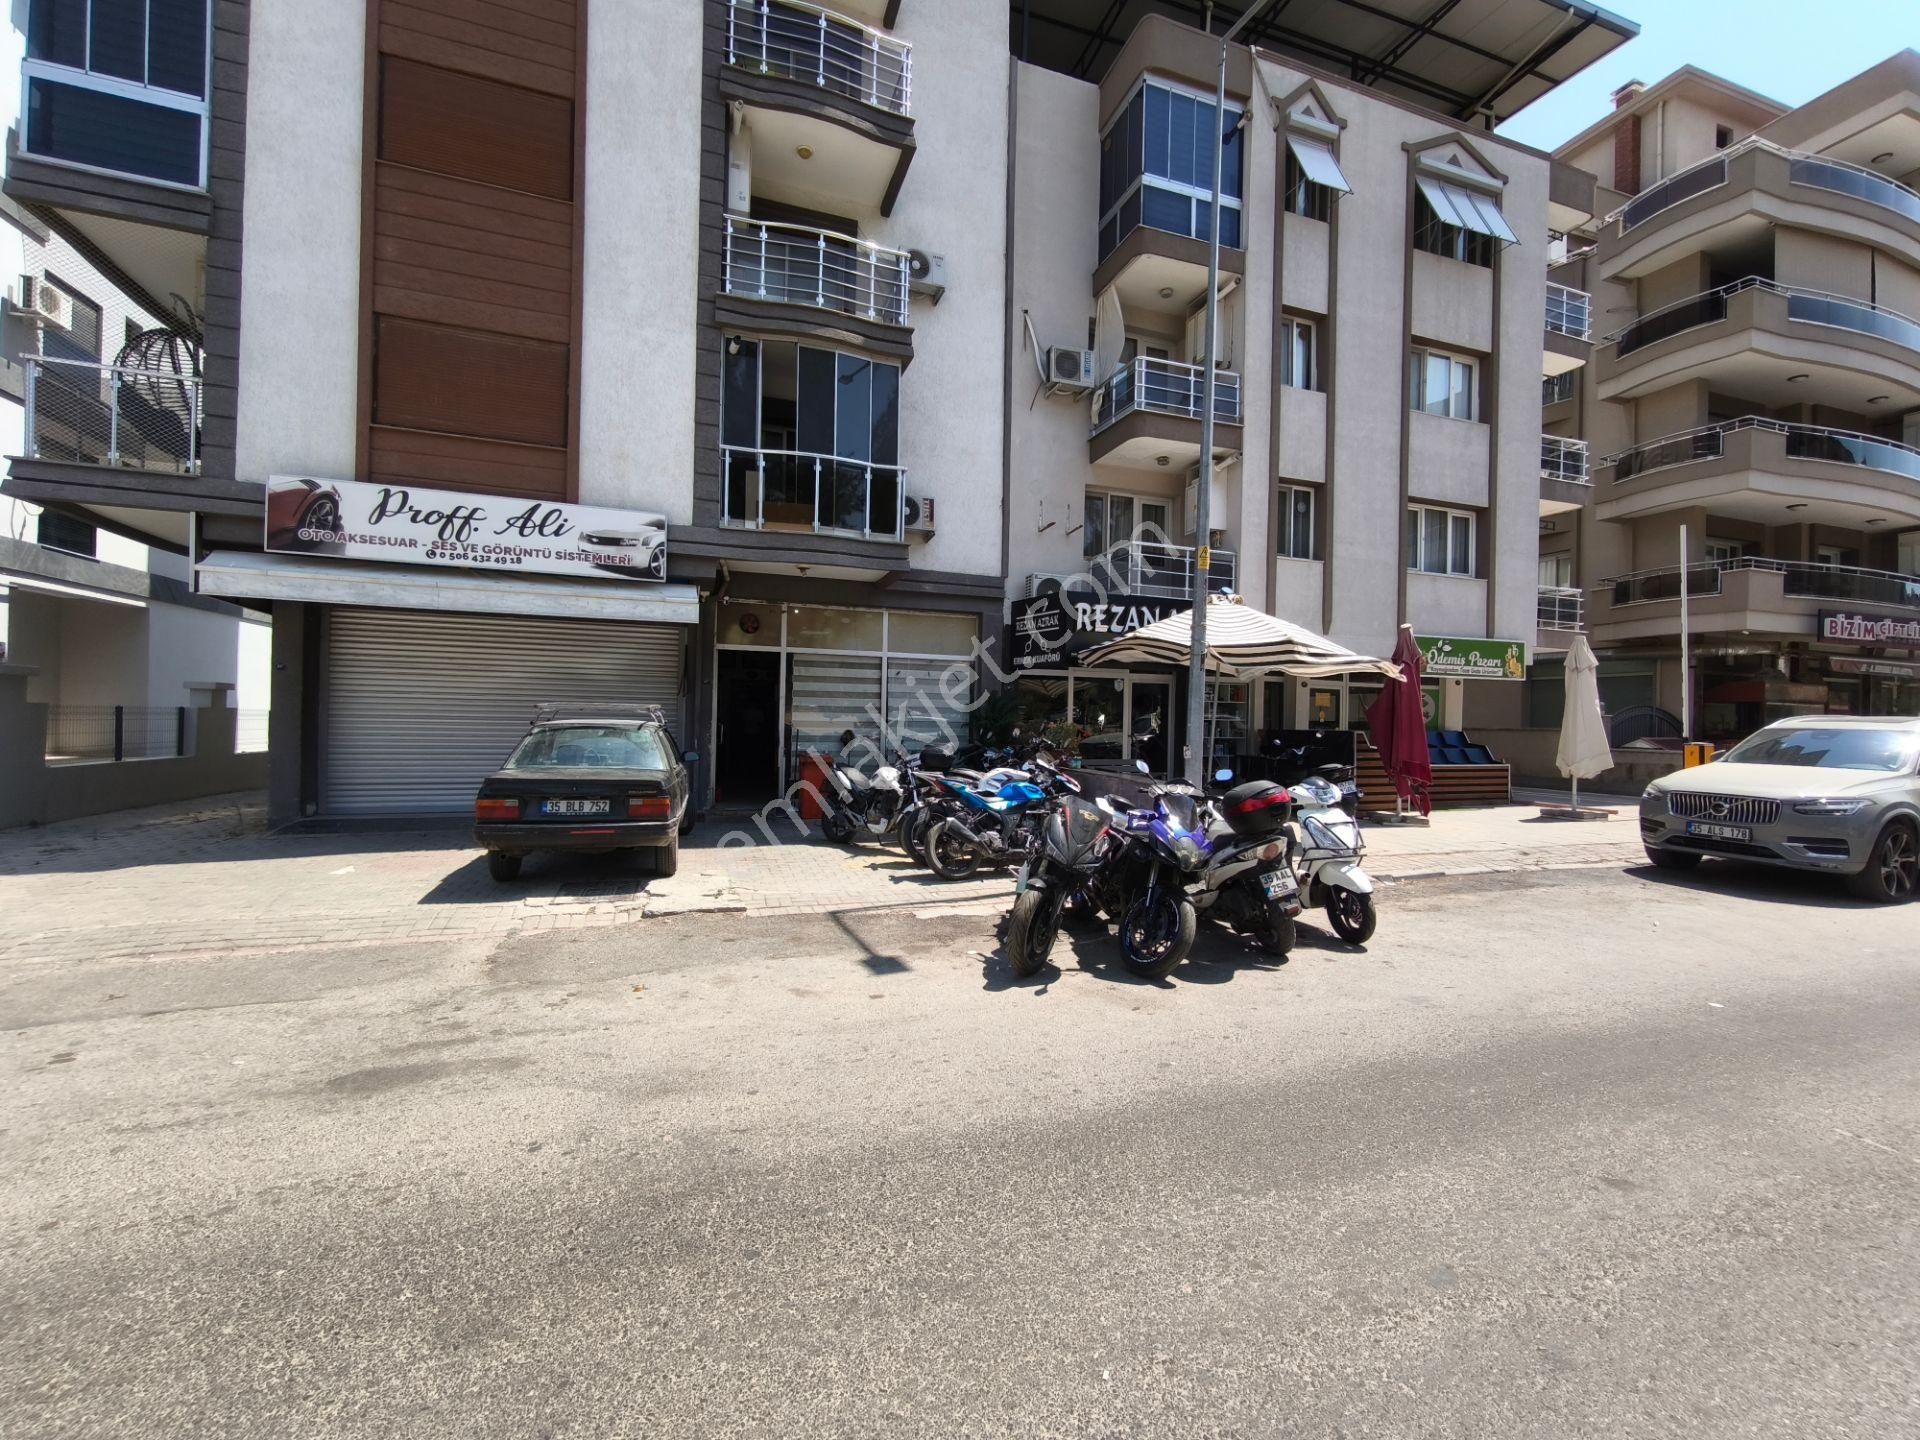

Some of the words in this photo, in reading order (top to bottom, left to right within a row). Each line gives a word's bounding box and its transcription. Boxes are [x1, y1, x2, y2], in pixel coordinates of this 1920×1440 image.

[368, 488, 488, 543] Proff.
[493, 503, 576, 538] Ali
[298, 528, 336, 543] OTO
[335, 531, 418, 548] AKSESUAR
[431, 540, 458, 552] SES
[461, 542, 479, 554] VE
[482, 543, 551, 560] GÖRÜNTÜ
[554, 549, 633, 566] SİSTEMLERİ
[449, 551, 470, 561] 506
[471, 553, 492, 563] 432
[494, 555, 508, 565] 49
[509, 556, 523, 565] 18
[1074, 602, 1160, 633] REZAN
[1824, 613, 1876, 640] BİZİM
[1427, 646, 1466, 667] Ödemiş
[1469, 651, 1502, 667] Pazarı
[548, 801, 561, 812] 35
[566, 801, 585, 812] BLB
[589, 801, 608, 812] 752
[1707, 825, 1724, 836] ALS
[1262, 874, 1273, 885] 35
[1274, 870, 1292, 881] AAL
